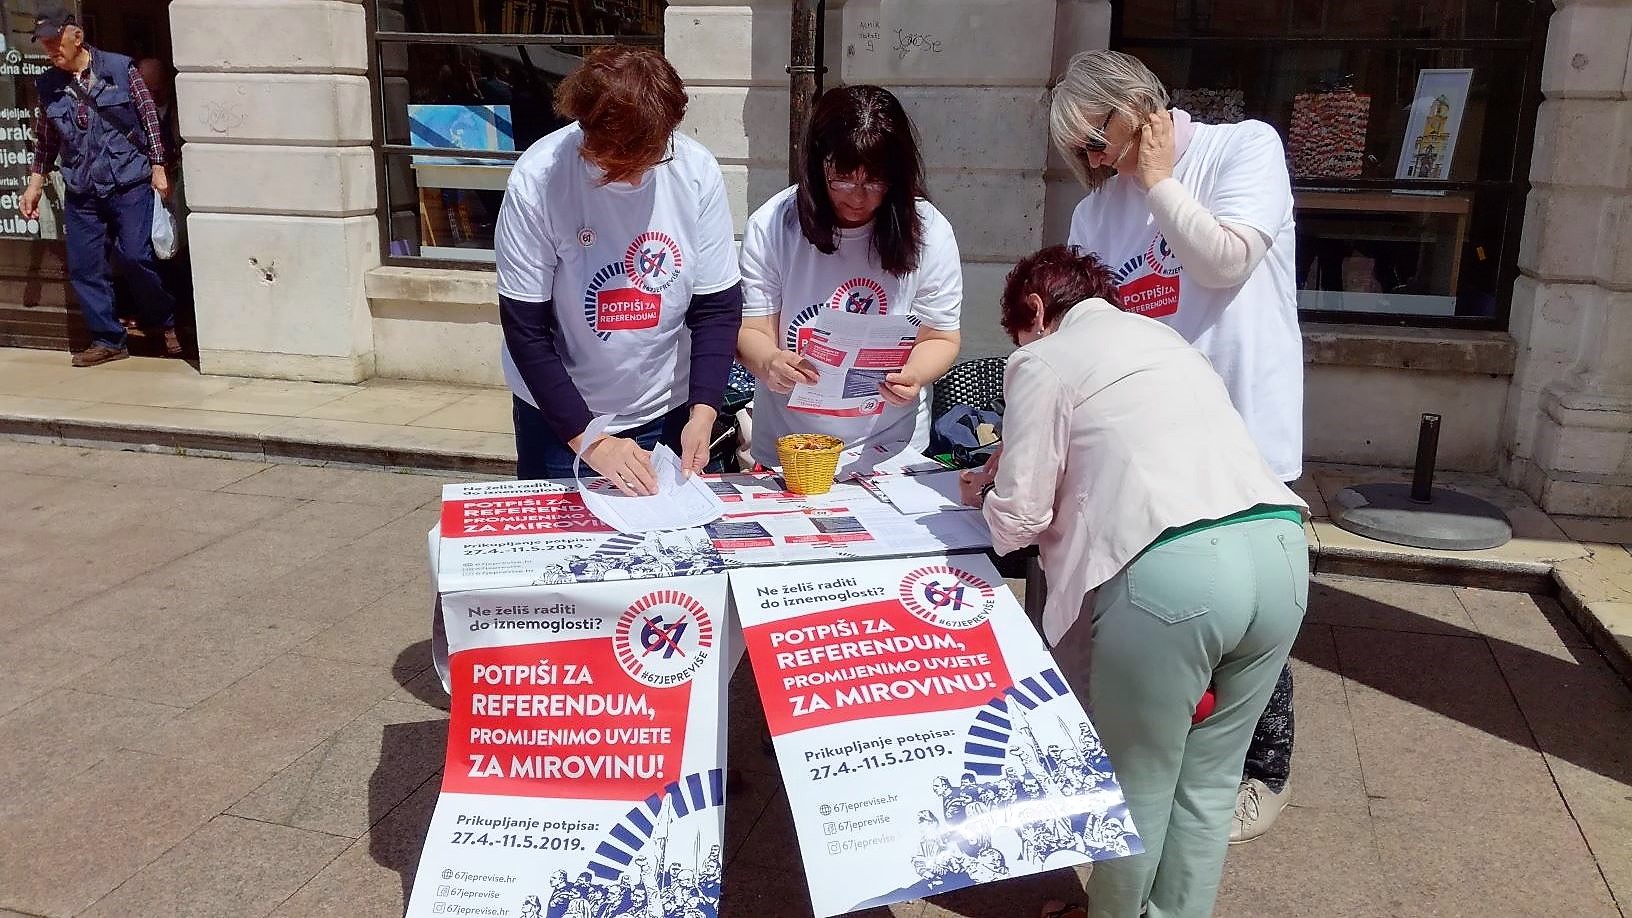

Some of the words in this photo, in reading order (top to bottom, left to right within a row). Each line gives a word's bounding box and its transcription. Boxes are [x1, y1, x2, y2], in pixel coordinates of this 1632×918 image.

[602, 299, 644, 312] POTPIŠI
[1124, 284, 1164, 306] POTPIŠI
[600, 312, 656, 322] REFERENDUM!
[464, 524, 498, 532] ZA
[756, 586, 778, 598] Ne
[782, 582, 814, 594] želiš
[818, 578, 856, 590] raditi
[760, 598, 780, 610] do
[783, 586, 886, 607] iznemoglosti?
[924, 580, 964, 610] 67
[468, 608, 490, 618] Ne
[496, 604, 530, 616] želiš
[534, 604, 576, 615] raditi
[938, 598, 995, 628] #67JEPREVIŠE
[470, 620, 490, 632] do
[494, 618, 602, 634] iznemoglosti?
[640, 615, 688, 659] 67
[770, 618, 857, 648] POTPIŠI
[862, 618, 896, 634] ZA
[776, 632, 966, 670] REFERENDUM,
[472, 660, 556, 685] POTPIŠI
[563, 665, 594, 684] ZA
[640, 650, 708, 684] #67JEPREVIŠE
[783, 660, 920, 690] PROMIJENIMO
[924, 654, 992, 670] UVJETE
[788, 692, 831, 717] ZA
[834, 672, 998, 708] MIROVINU!
[472, 694, 656, 720] REFERENDUM,
[470, 728, 600, 746] PROMIJENIMO
[606, 727, 672, 744] UVJETE
[804, 736, 892, 762] Prikupljanje
[897, 730, 956, 746] potpisa:
[468, 754, 504, 778] ZA
[510, 754, 664, 779] MIROVINU!
[810, 744, 953, 781] 27.4.-11.5.2019.
[834, 794, 898, 812] 67jeprevise.hr
[456, 814, 540, 830] Prikupljanje
[543, 820, 600, 833] potpisa:
[450, 832, 586, 851] 27.4.-11.5.2019.
[454, 872, 516, 884] 67jeprevise.hr
